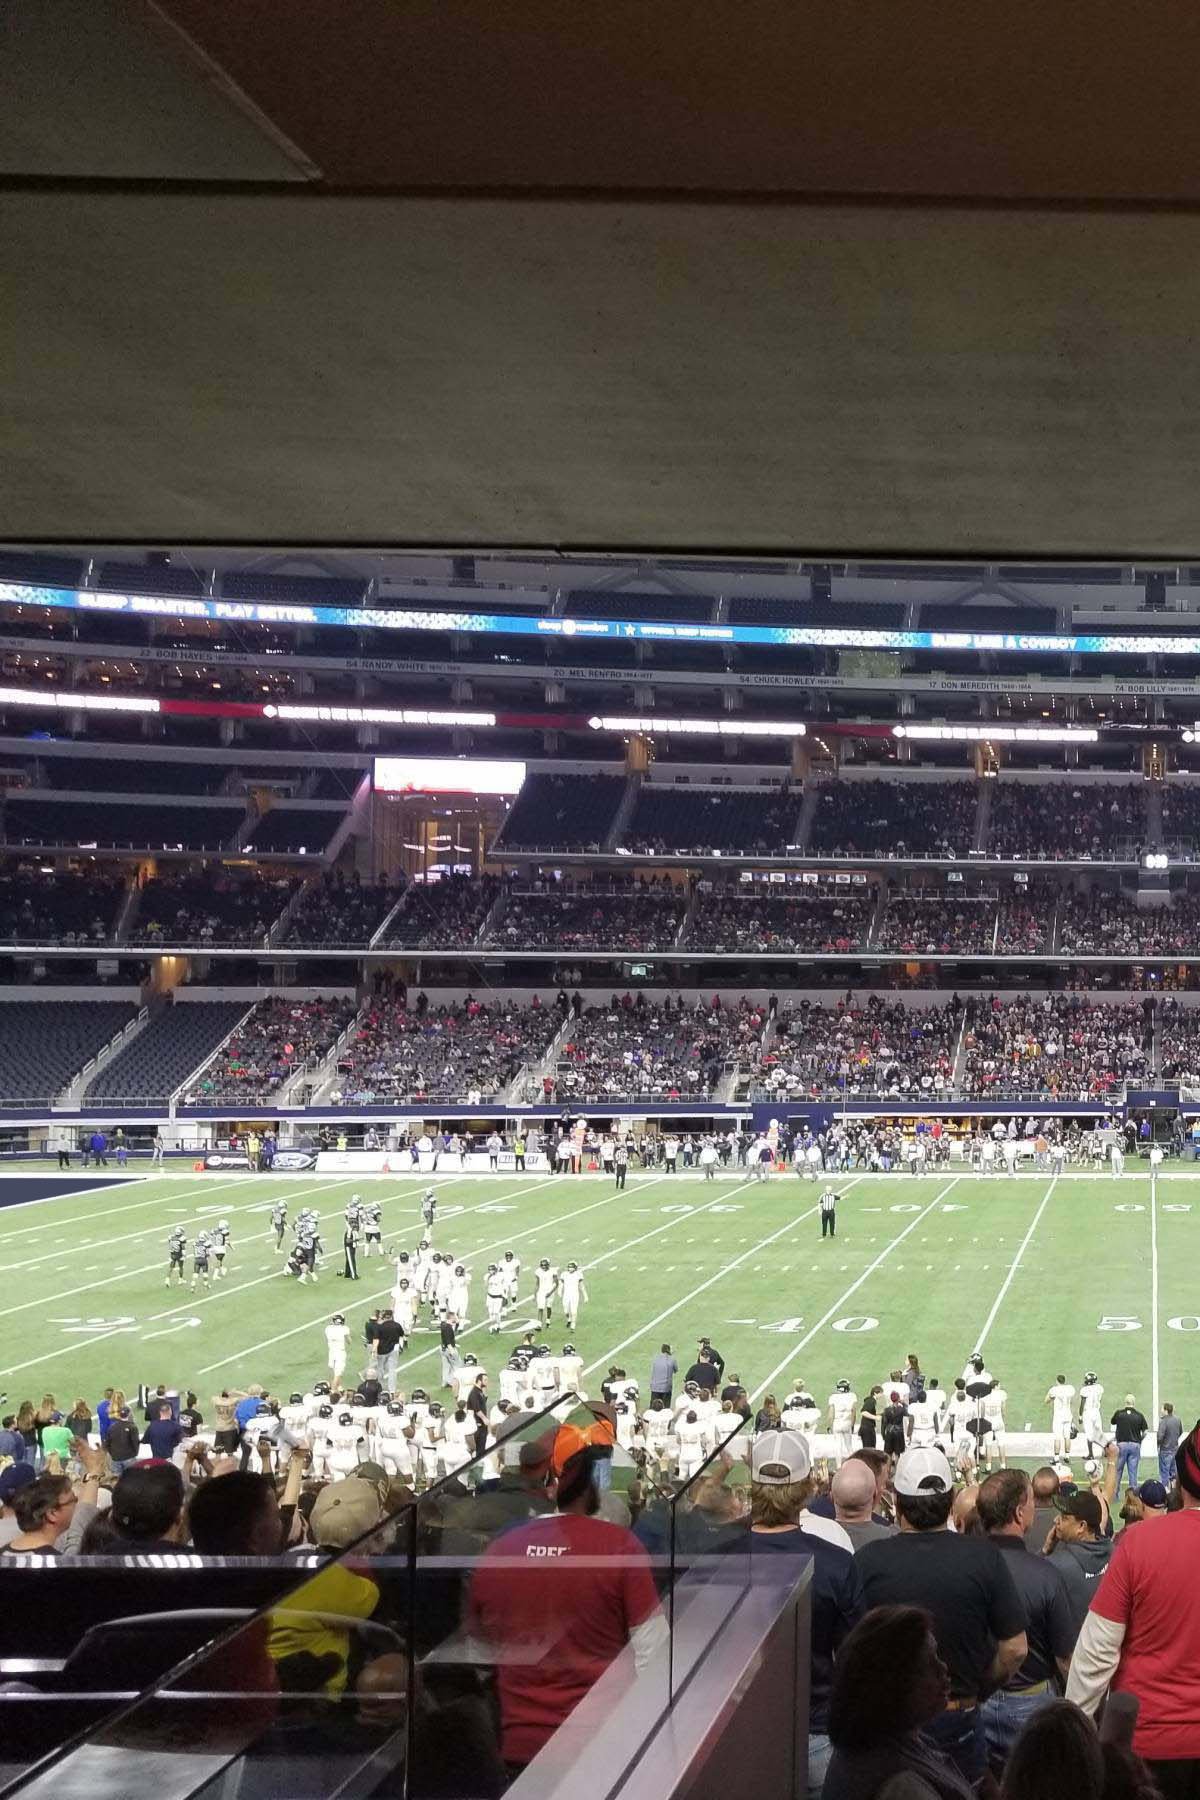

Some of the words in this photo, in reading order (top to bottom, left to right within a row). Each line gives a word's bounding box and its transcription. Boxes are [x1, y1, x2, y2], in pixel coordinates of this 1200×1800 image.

[216, 603, 254, 618] PLAY
[1005, 635, 1016, 649] A
[1019, 636, 1077, 650] COWBOY
[156, 650, 177, 658] BOB
[181, 652, 213, 661] HAYES
[362, 661, 393, 671] RANDY
[396, 662, 425, 671] WHITE
[553, 669, 565, 677] 20
[569, 670, 586, 678] MEL
[588, 670, 622, 679] RENFRO
[740, 675, 751, 683] 54
[753, 676, 781, 685] CHUCK
[782, 677, 816, 686] HOWLEY
[929, 681, 937, 689] 17
[941, 681, 958, 690] DON
[960, 682, 999, 691] MEREDITH
[1127, 685, 1145, 693] BOB
[1146, 685, 1166, 693] LILLY
[759, 1316, 880, 1333] 40
